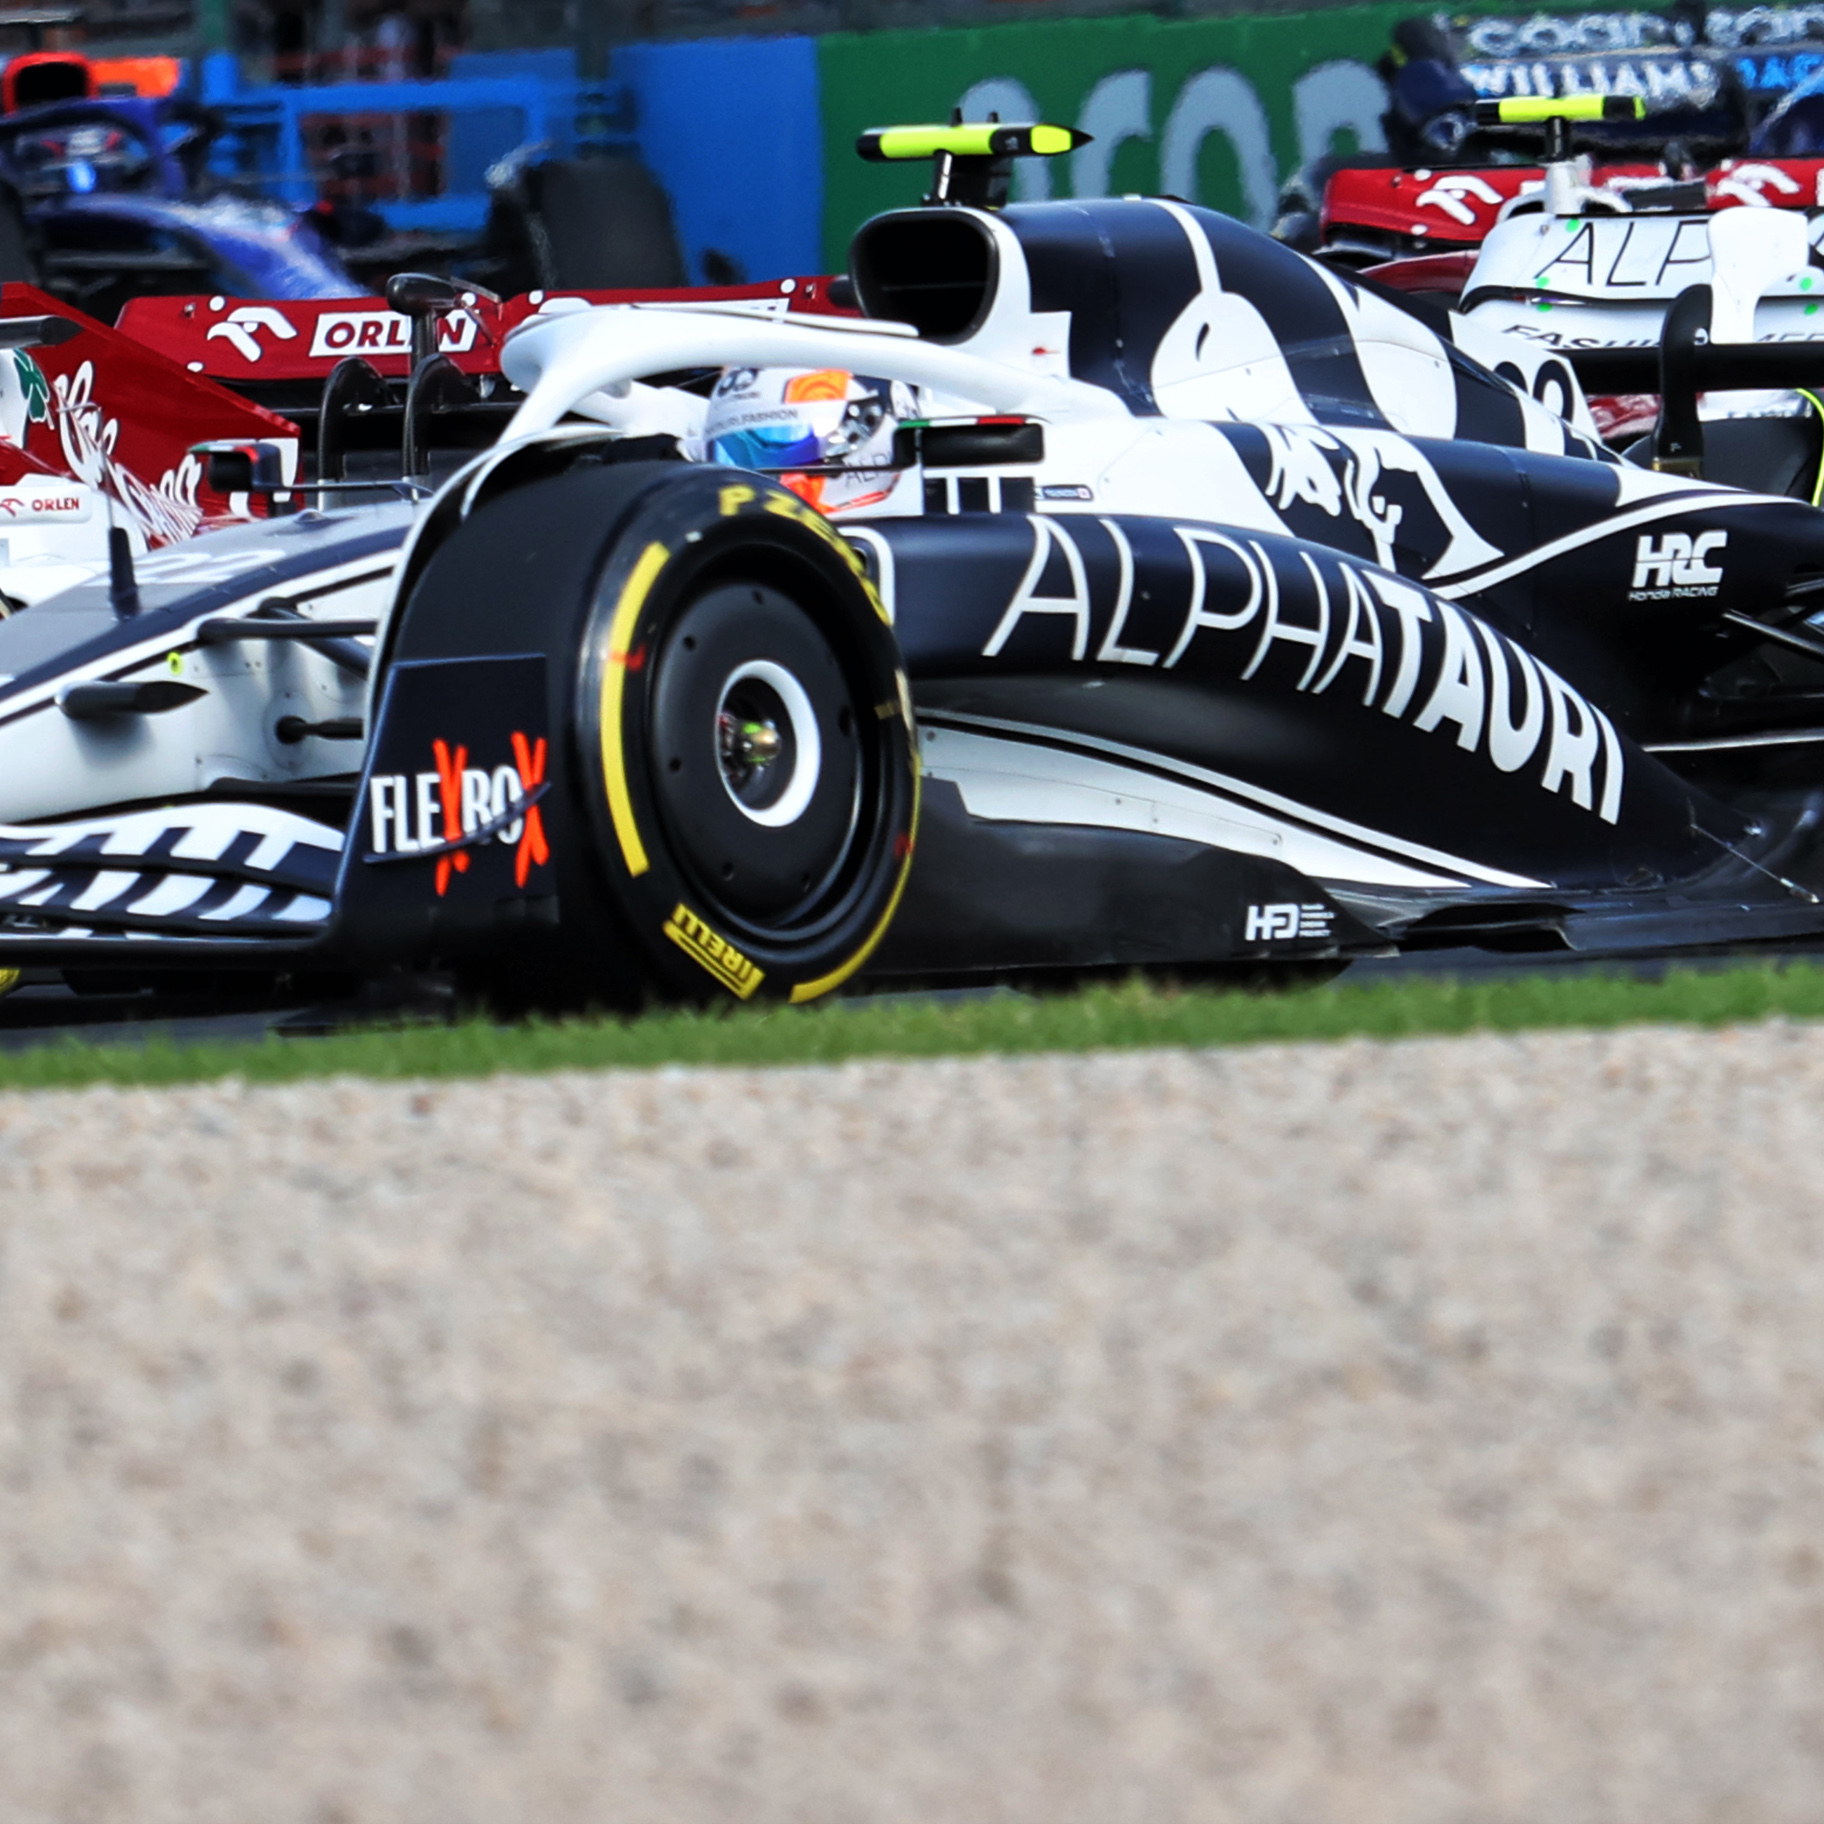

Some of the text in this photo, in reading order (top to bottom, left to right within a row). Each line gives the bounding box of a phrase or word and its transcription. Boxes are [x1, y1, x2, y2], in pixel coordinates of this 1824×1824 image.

[324, 316, 467, 349] ORLN
[31, 496, 80, 512] ORLEN
[719, 483, 757, 517] P
[1632, 529, 1728, 588] HRC
[1672, 586, 1719, 598] RACING
[982, 513, 1623, 827] ALPHATAURI
[369, 730, 550, 897] FLEXBOX
[663, 902, 766, 1001] PIRELLI
